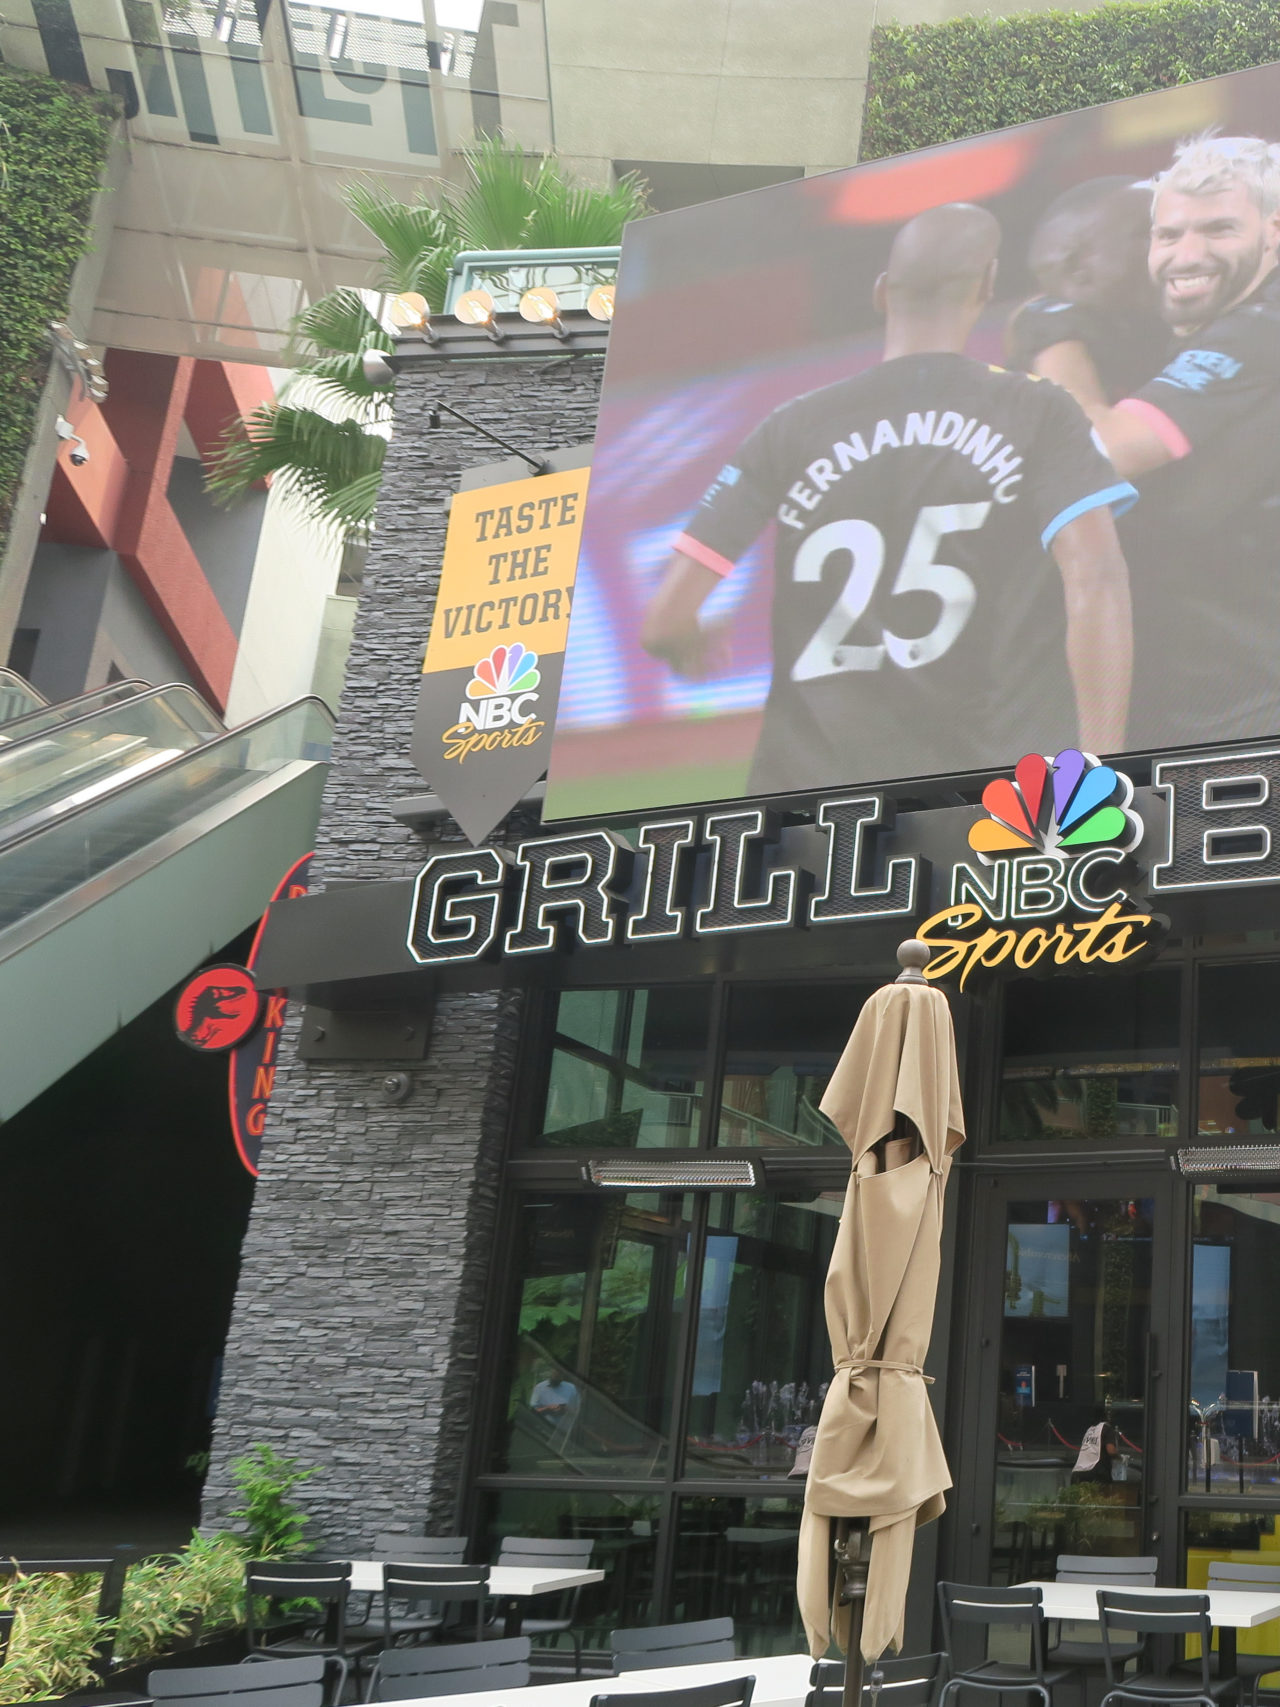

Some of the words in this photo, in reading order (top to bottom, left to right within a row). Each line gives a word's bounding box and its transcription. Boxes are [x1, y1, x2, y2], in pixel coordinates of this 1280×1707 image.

[475, 492, 579, 542] TASTE
[488, 543, 552, 585] THE
[790, 500, 977, 682] 25
[442, 717, 545, 765] Sports
[457, 692, 540, 733] NBC
[404, 794, 920, 965] GRILL
[948, 847, 1128, 926] NBC
[916, 902, 1152, 994] Sports
